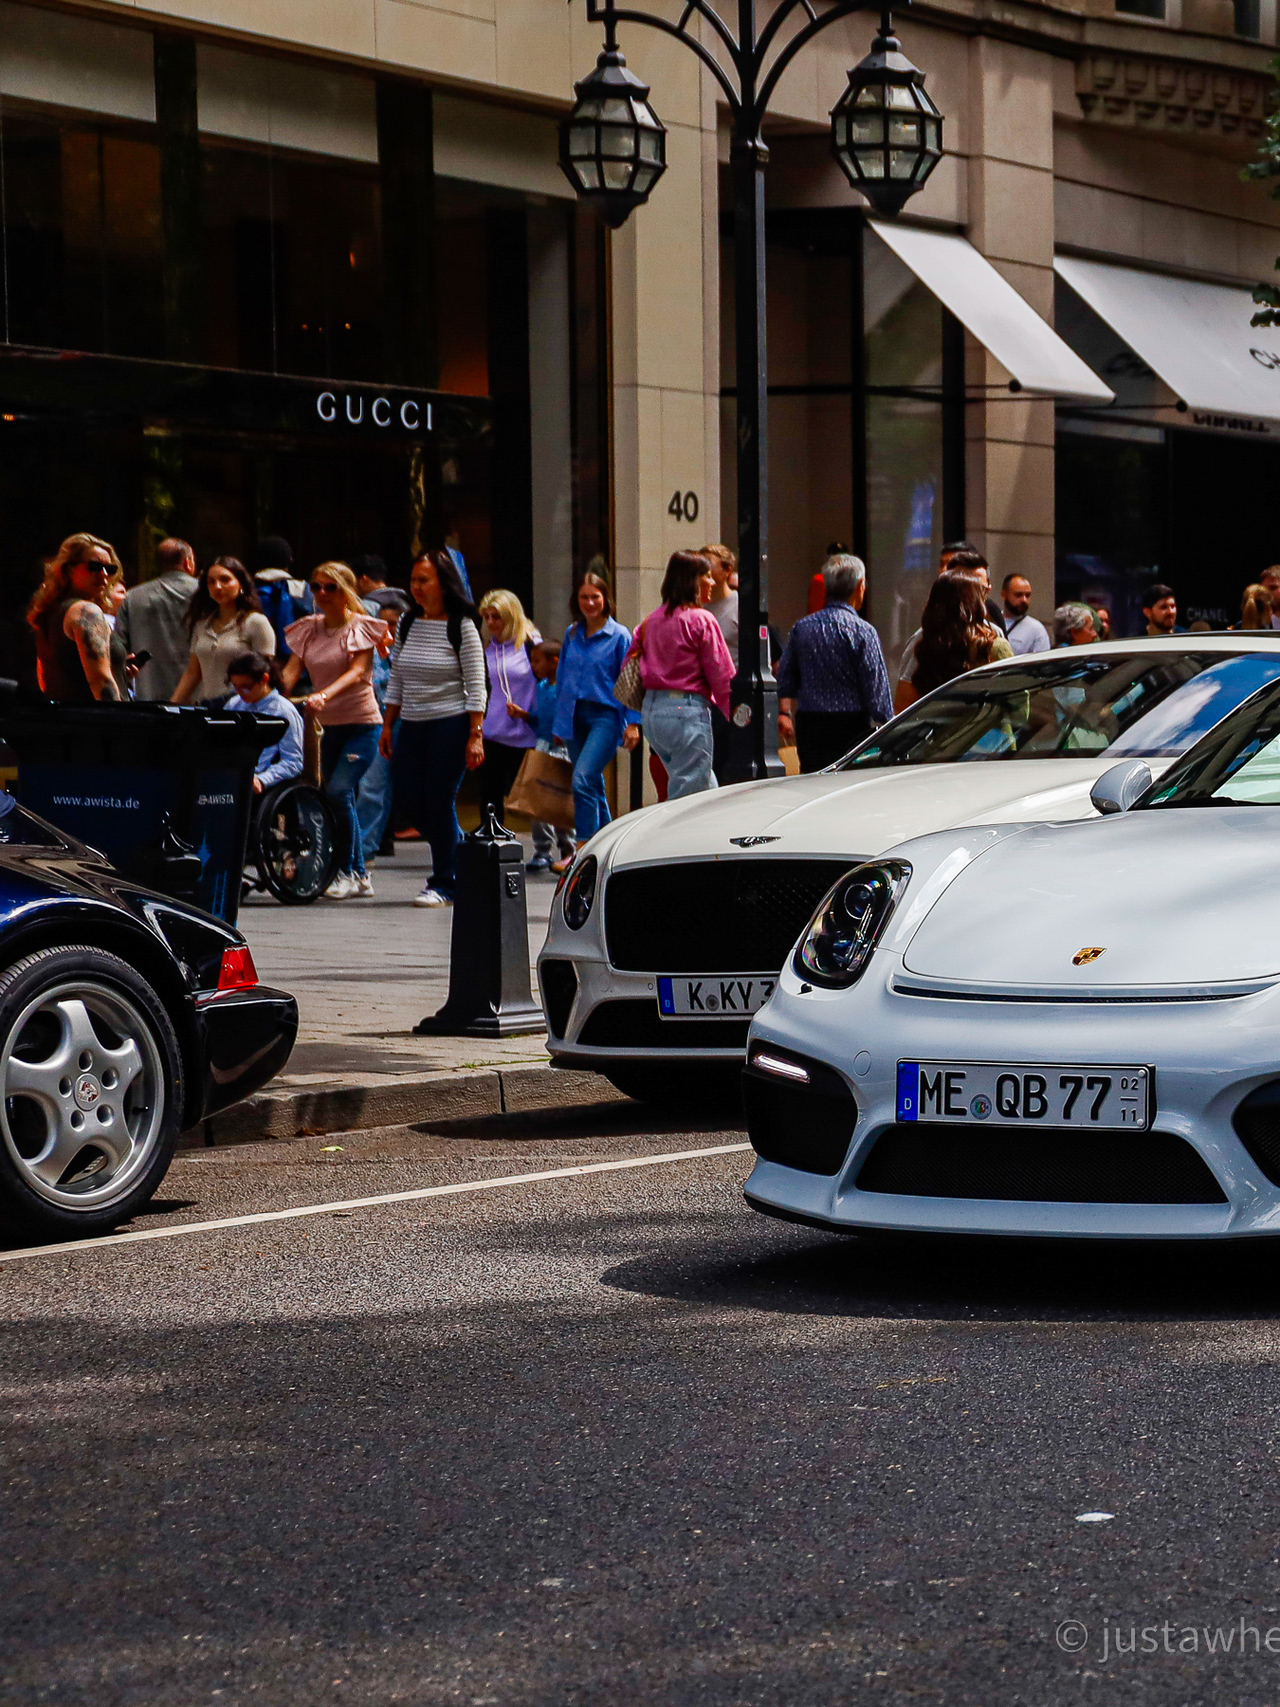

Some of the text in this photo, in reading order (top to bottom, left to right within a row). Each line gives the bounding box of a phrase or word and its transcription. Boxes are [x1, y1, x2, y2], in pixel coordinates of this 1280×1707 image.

[316, 391, 433, 431] GUCCI
[667, 490, 699, 523] 40
[1186, 606, 1229, 622] CHANEL
[53, 795, 140, 809] www.awista.de
[687, 981, 705, 1011] K
[719, 981, 753, 1011] KY
[1120, 1077, 1139, 1090] 02
[919, 1069, 1112, 1120] ME QB 77
[904, 1098, 912, 1110] D
[1120, 1109, 1137, 1122] 11
